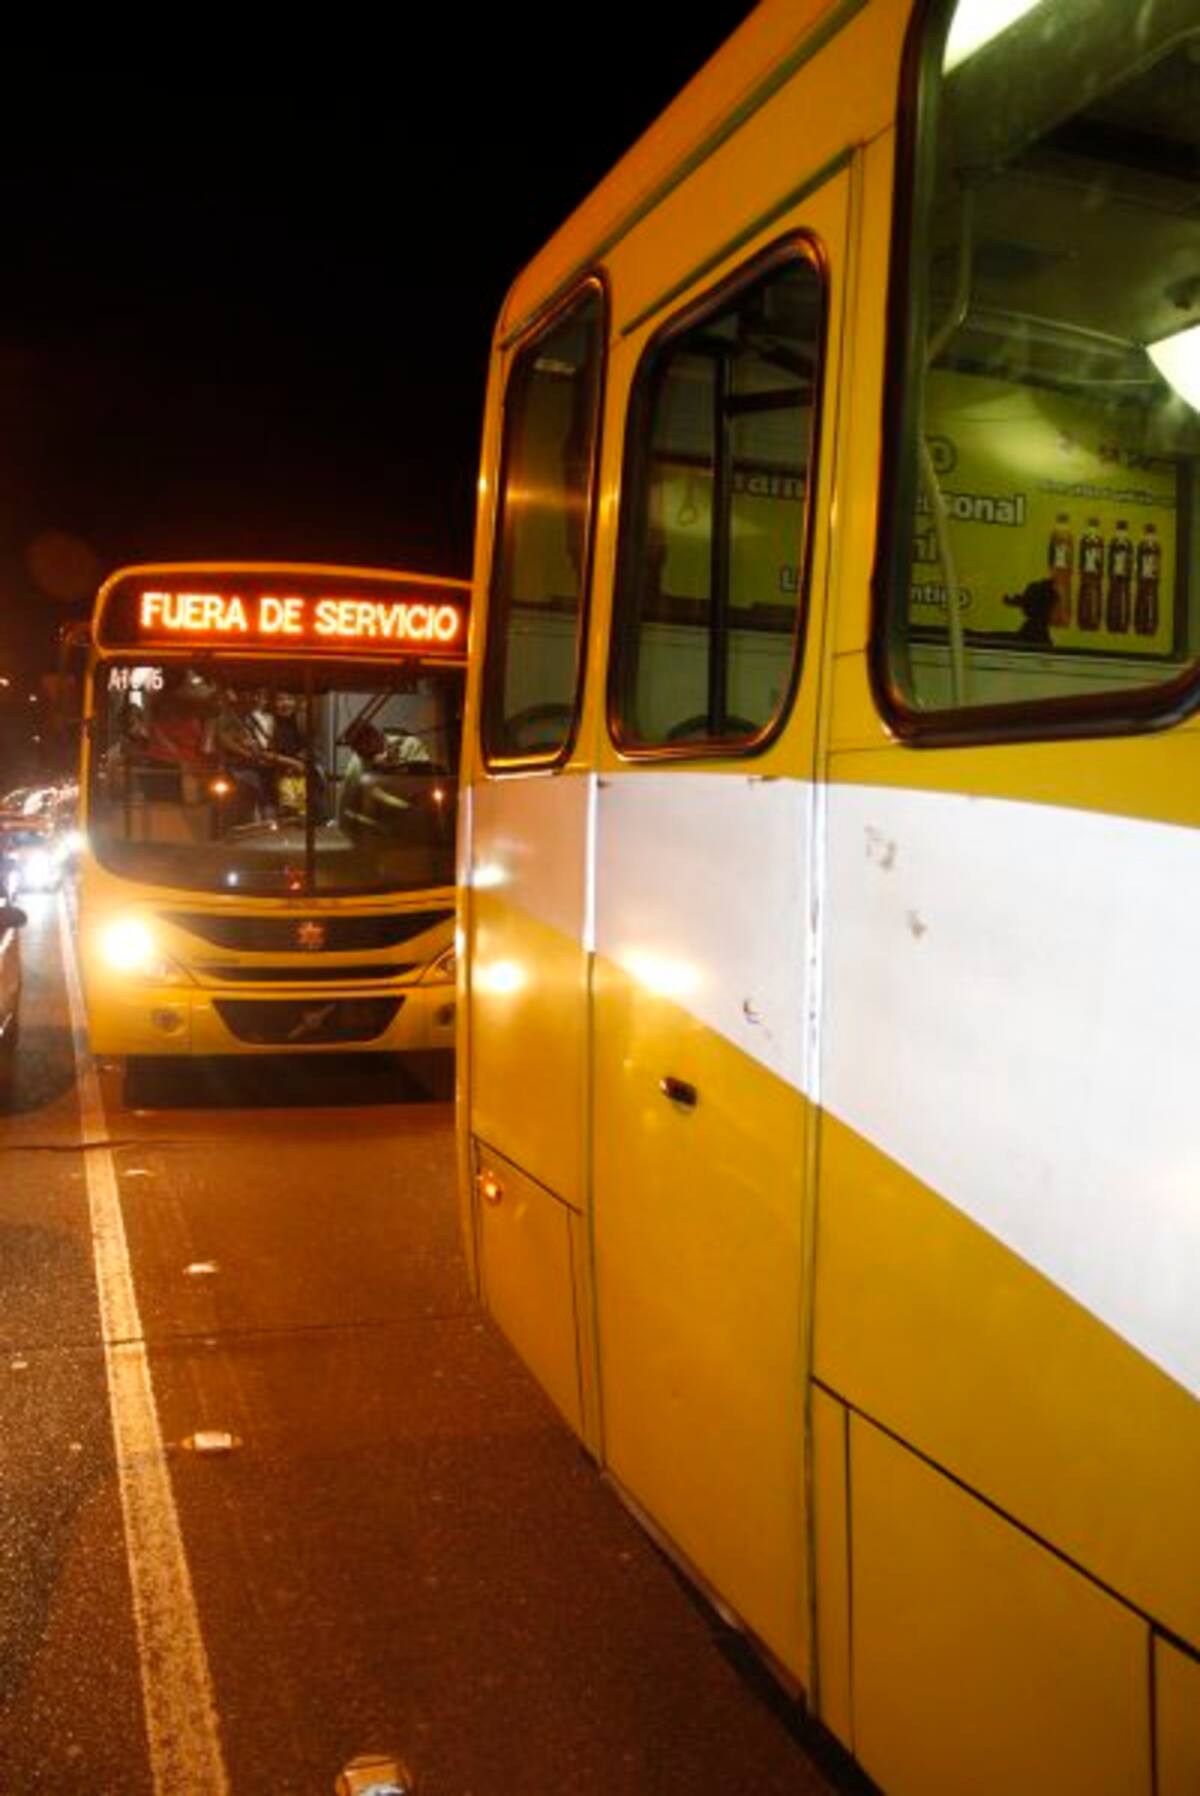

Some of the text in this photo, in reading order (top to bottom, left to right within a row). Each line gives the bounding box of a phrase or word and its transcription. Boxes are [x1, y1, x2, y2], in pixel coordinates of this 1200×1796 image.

[141, 592, 459, 641] FUERA DE SERVICIO
